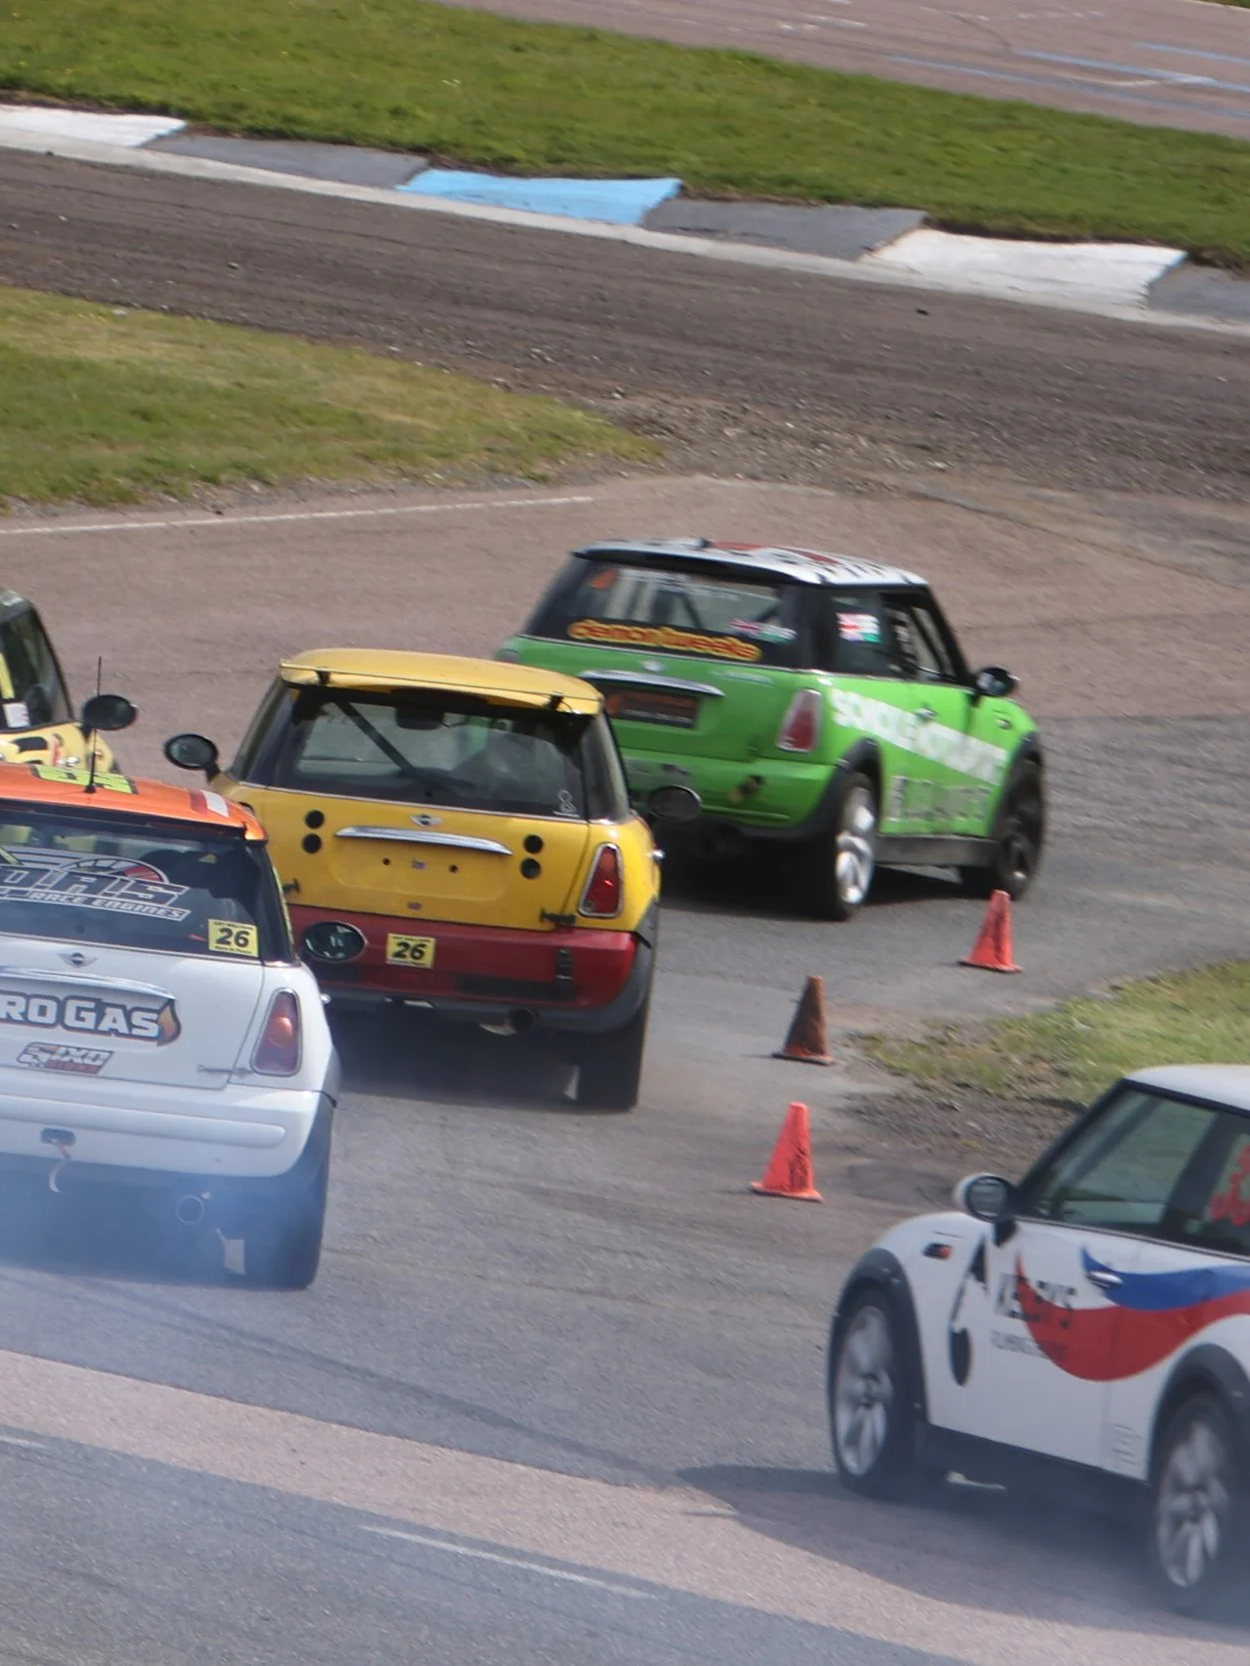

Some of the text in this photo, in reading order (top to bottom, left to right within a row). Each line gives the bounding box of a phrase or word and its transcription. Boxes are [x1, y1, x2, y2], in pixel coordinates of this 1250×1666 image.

[29, 891, 184, 919] RACE ENGINES
[215, 927, 251, 949] 26
[392, 941, 427, 960] 26
